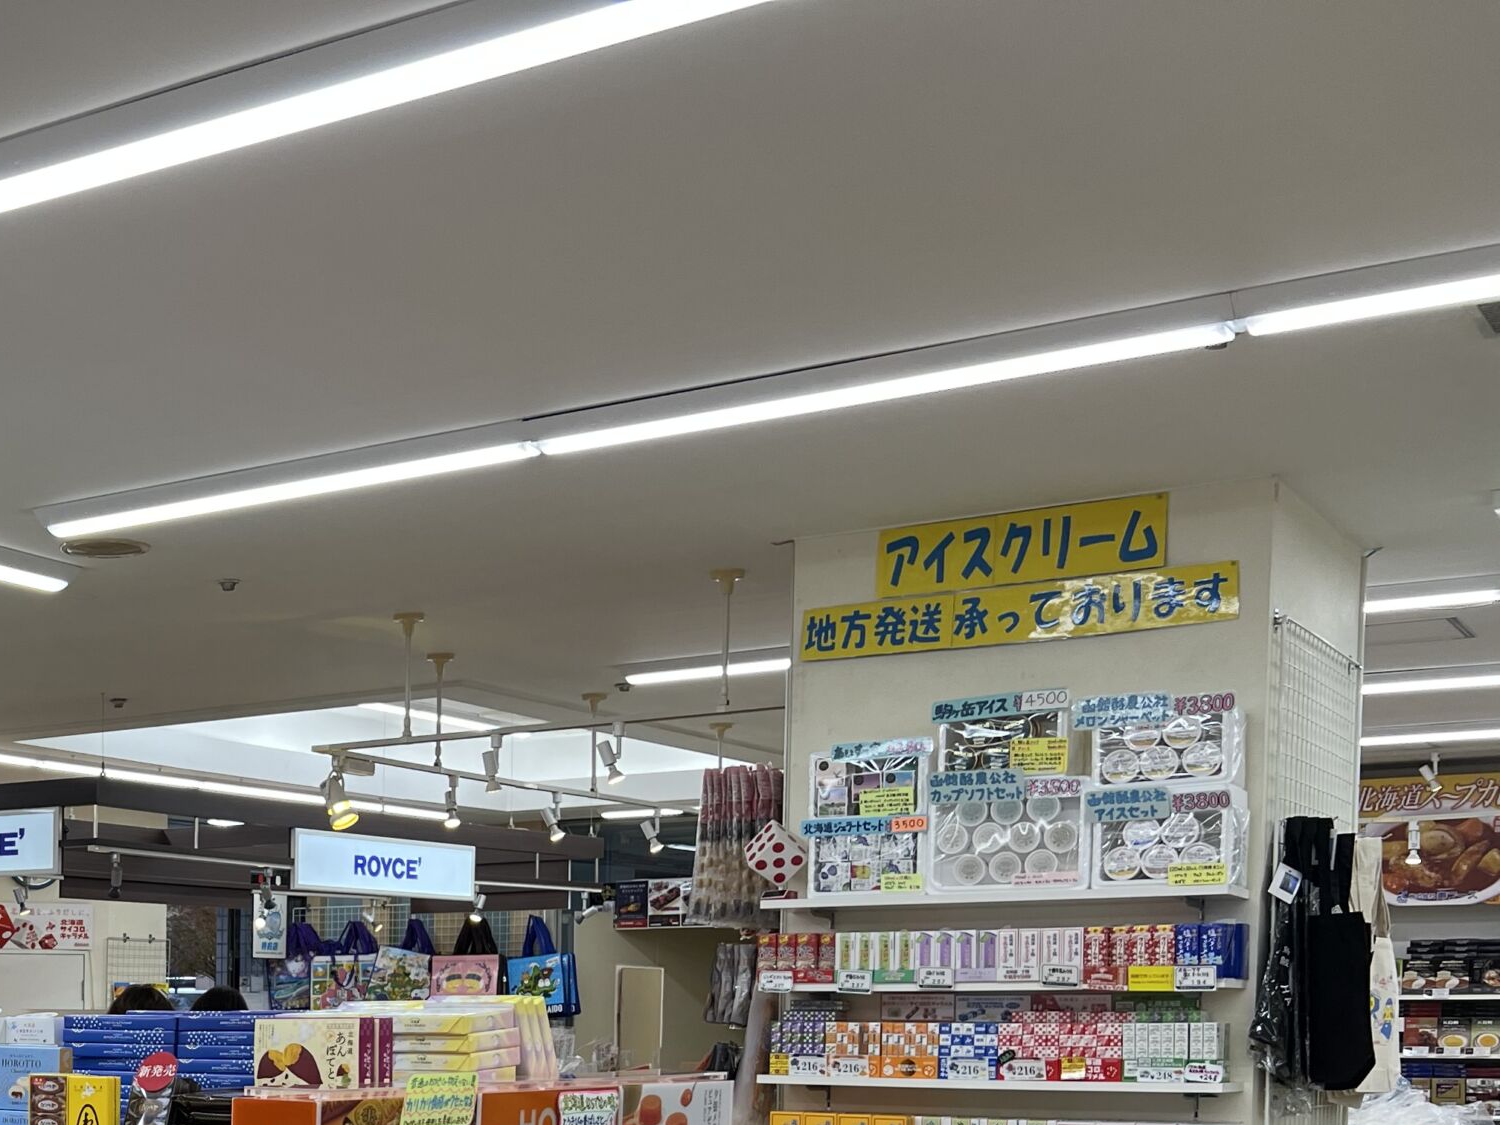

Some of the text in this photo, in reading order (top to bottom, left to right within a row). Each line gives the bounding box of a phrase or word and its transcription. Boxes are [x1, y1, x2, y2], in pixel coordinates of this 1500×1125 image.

[885, 509, 1159, 587] アイスクリーム
[1173, 692, 1235, 716] ¥3800
[930, 786, 1023, 802] カップソフトセット
[1172, 790, 1231, 813] ¥3800
[1359, 778, 1500, 812] 北海道スープカ
[1094, 805, 1159, 821] アイスセット
[353, 854, 422, 880] ROYCE'
[59, 925, 87, 933] サイコロ
[59, 932, 90, 941] キャラメル
[1, 1059, 42, 1069] HOROTTO
[137, 1063, 177, 1079] 新発売
